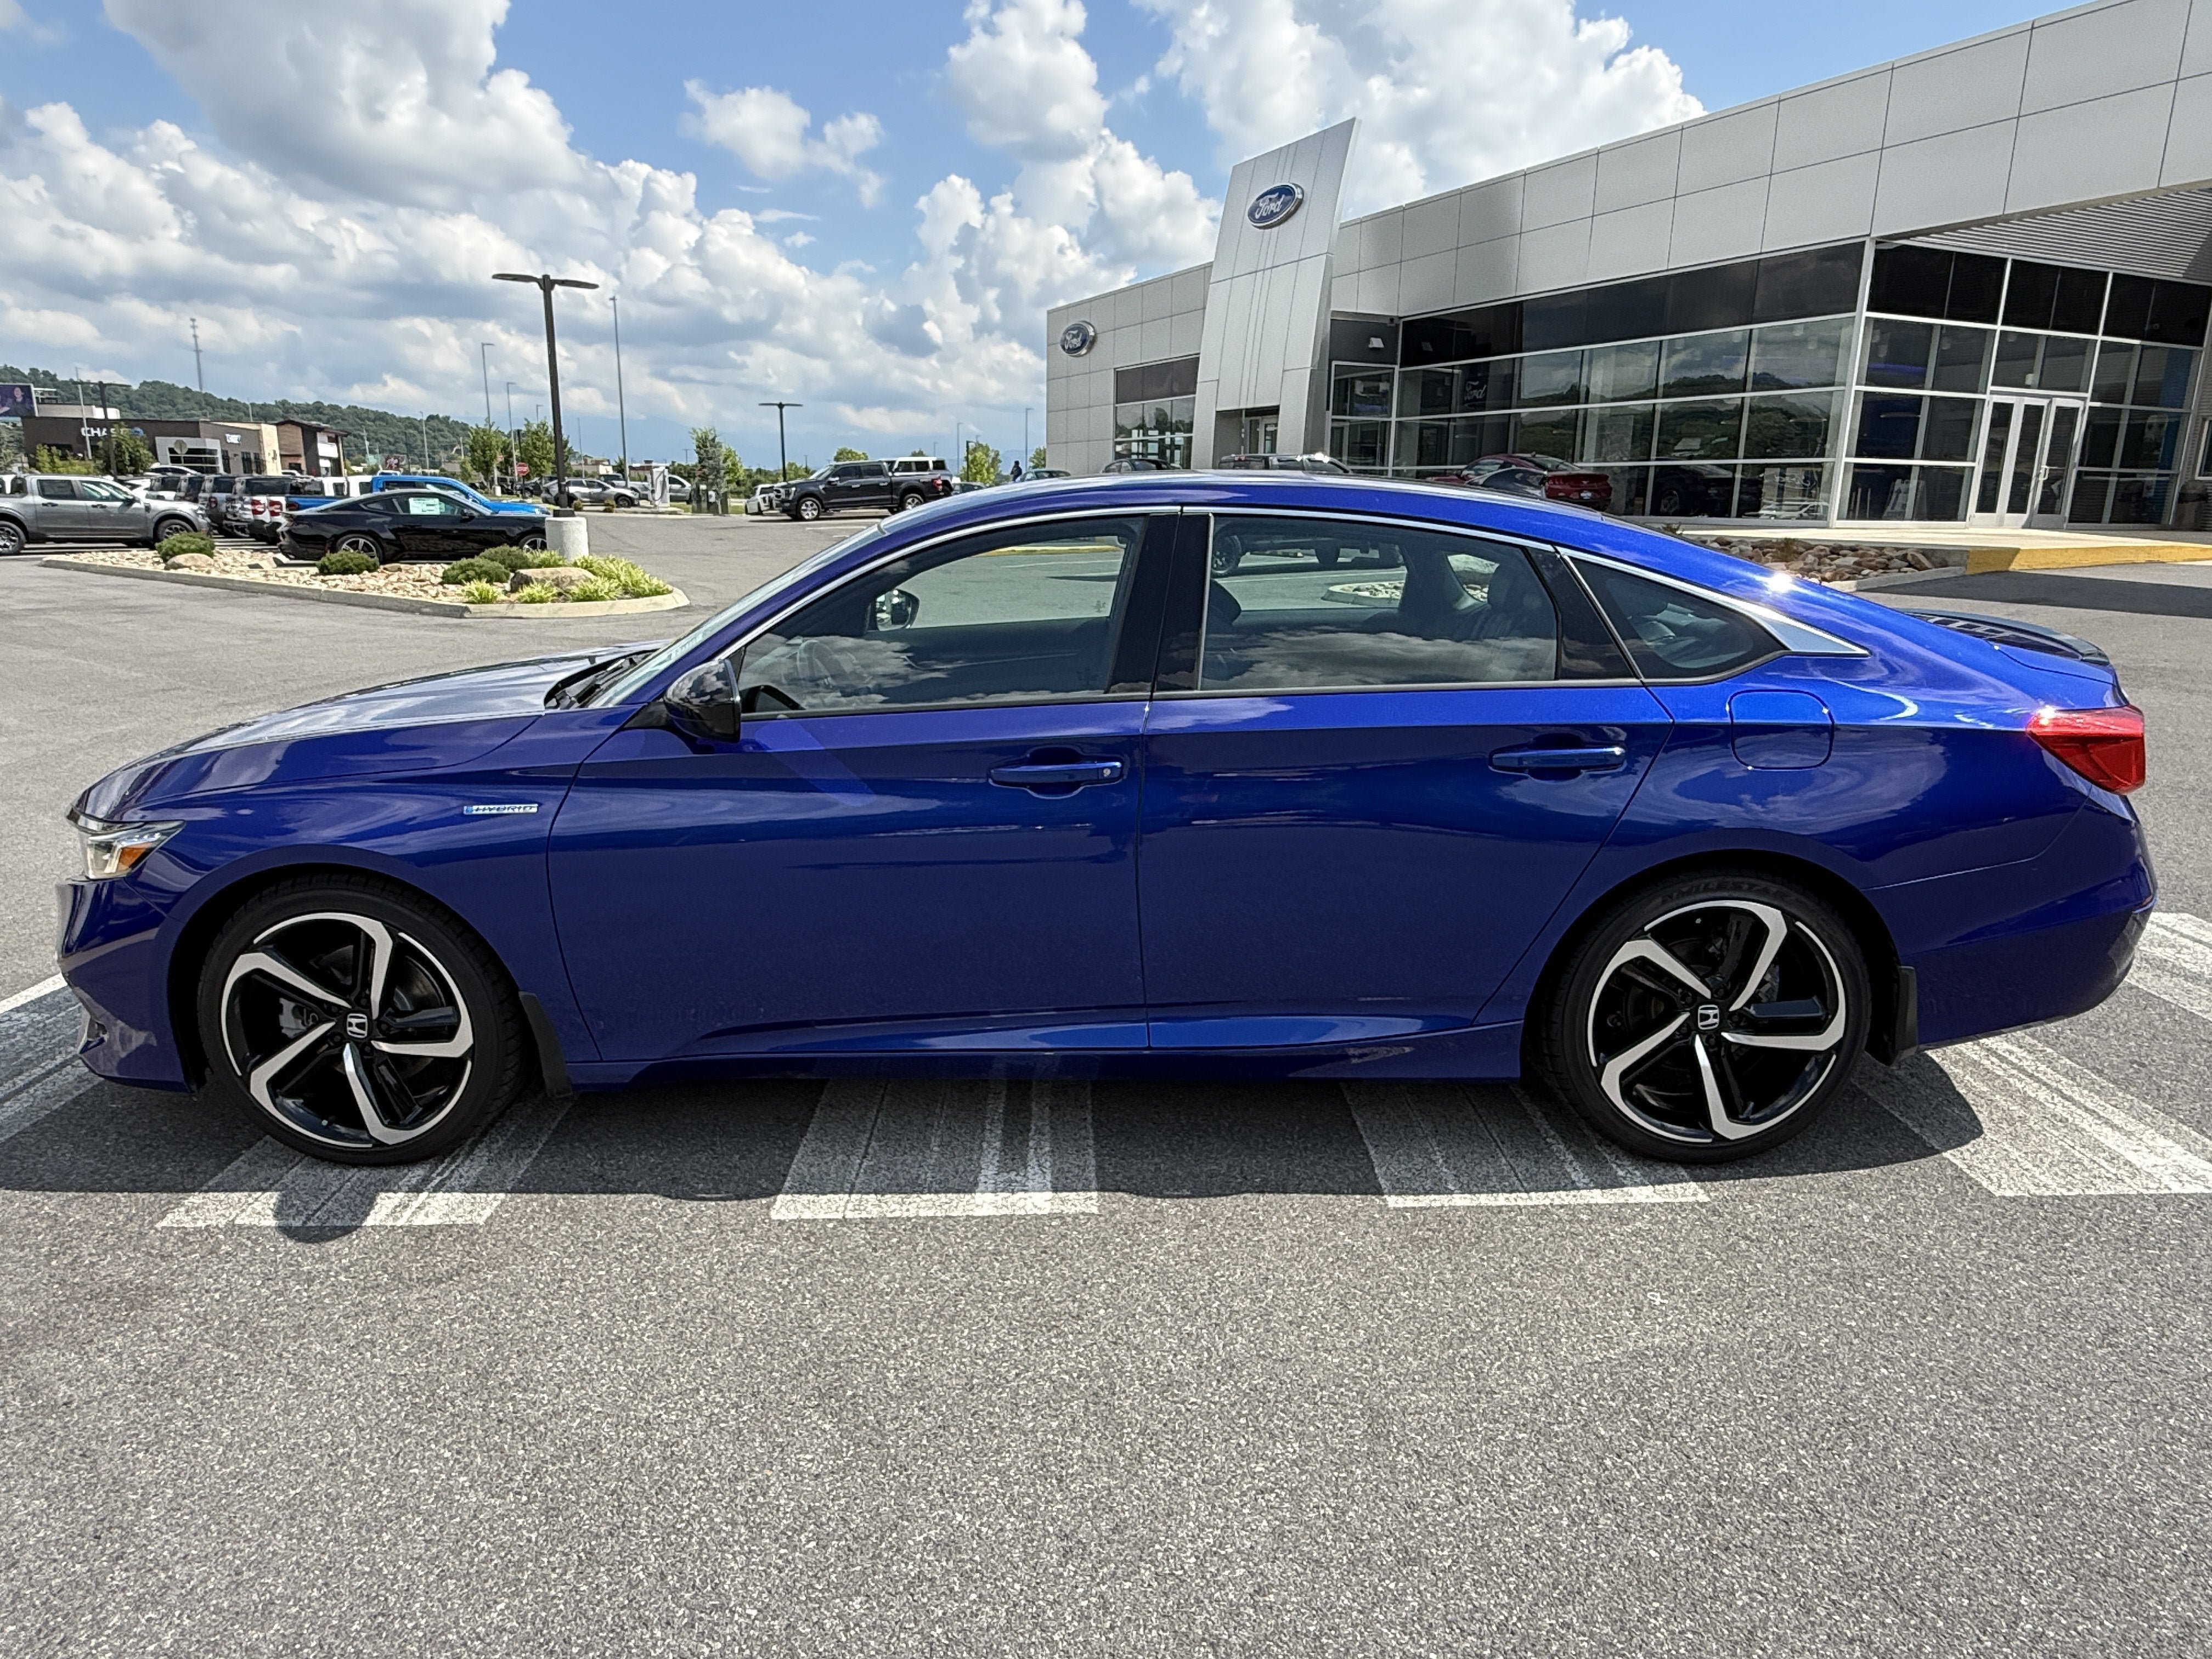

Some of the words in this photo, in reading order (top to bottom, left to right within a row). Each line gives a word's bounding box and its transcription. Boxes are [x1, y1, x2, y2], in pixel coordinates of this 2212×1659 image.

[1255, 193, 1285, 219] Ford
[1065, 330, 1083, 349] Ford
[1465, 381, 1486, 400] Ford
